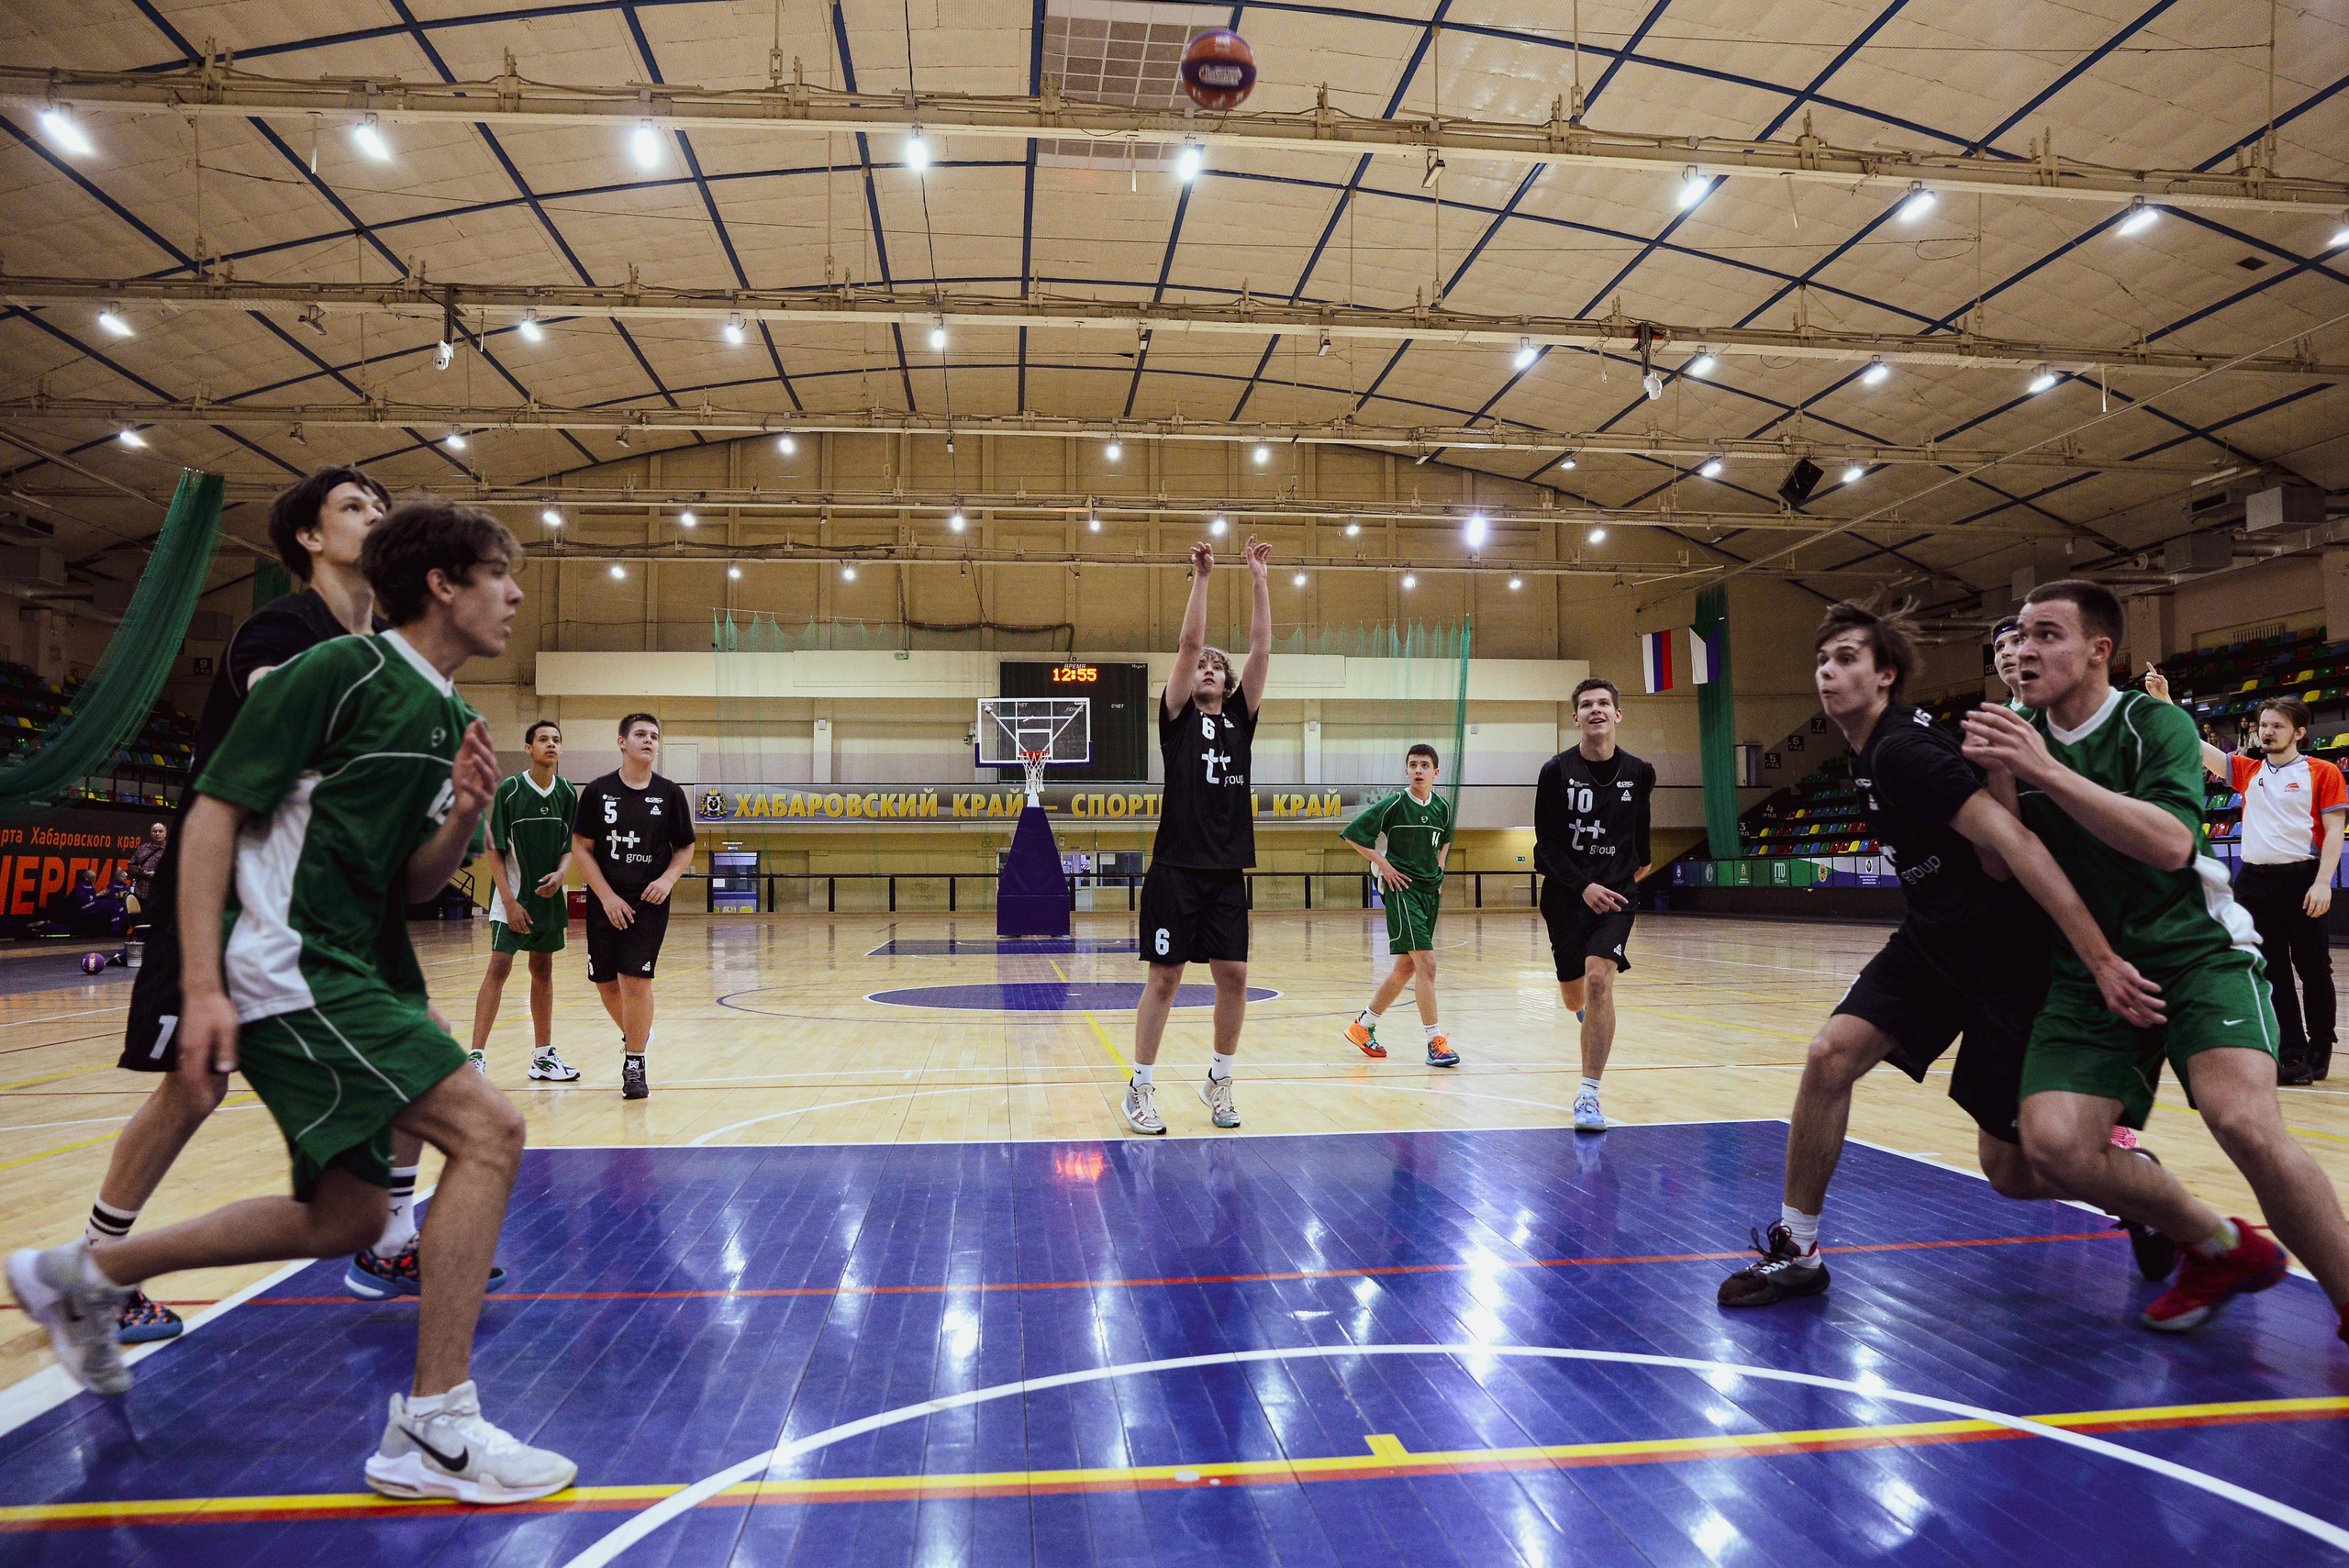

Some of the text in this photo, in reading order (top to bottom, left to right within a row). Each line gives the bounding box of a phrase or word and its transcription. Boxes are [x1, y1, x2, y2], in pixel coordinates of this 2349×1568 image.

[1052, 668, 1097, 682] 12:55
[1202, 717, 1216, 740] 6
[1815, 719, 1822, 728] 7
[1792, 737, 1799, 745] 6
[1769, 754, 1776, 762] 5
[735, 788, 938, 817] ХАБАРОВСКИЙ
[952, 788, 1024, 817] КРАЙ
[1273, 788, 1341, 817] КРАЙ
[1567, 788, 1594, 813] 10
[604, 801, 618, 824] 5
[1765, 804, 1774, 813] 4
[1739, 822, 1746, 831] 3
[0, 827, 141, 851] рта Хабаровского края
[1589, 844, 1616, 857] group
[626, 853, 652, 864] group
[1900, 855, 1942, 884] group
[1155, 928, 1170, 956] 6
